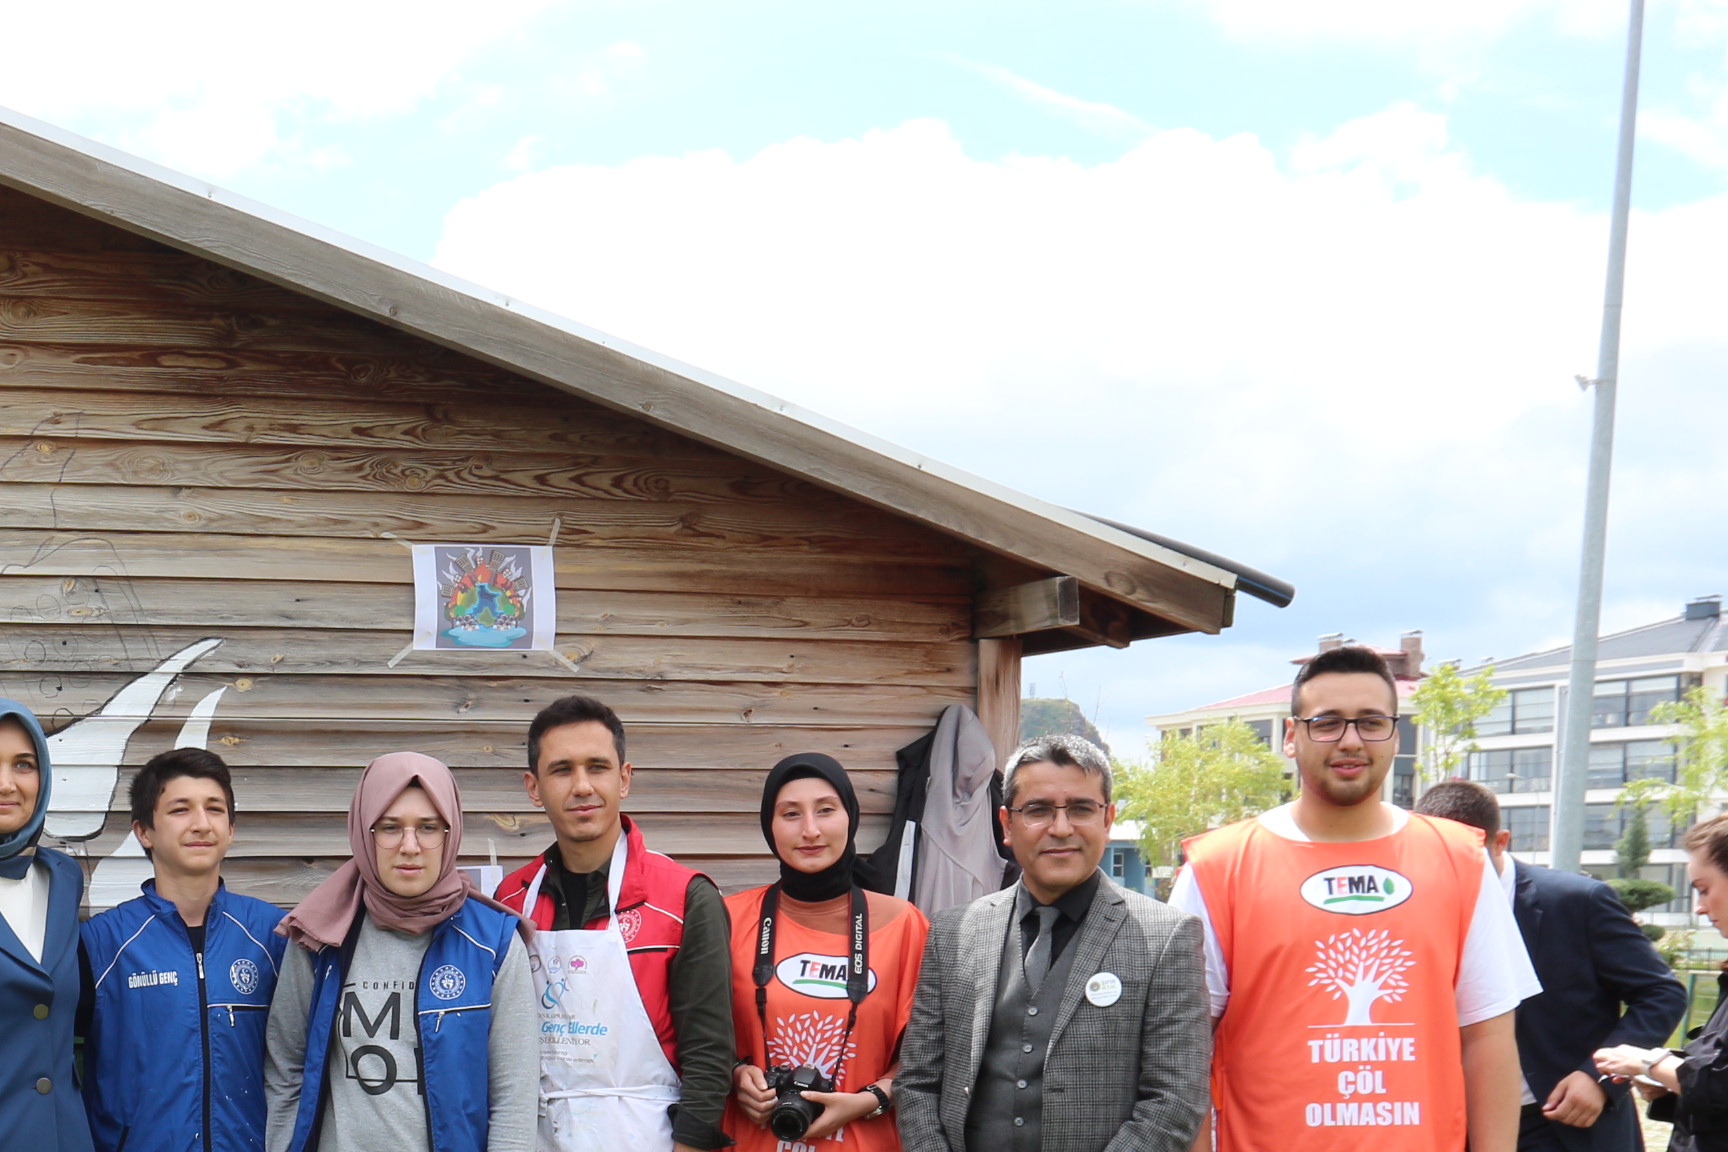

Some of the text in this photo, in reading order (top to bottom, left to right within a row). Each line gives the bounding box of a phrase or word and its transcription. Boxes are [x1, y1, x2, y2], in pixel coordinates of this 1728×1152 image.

[1324, 875, 1379, 895] TEMA
[760, 917, 772, 955] Canon
[854, 913, 863, 974] EOS DIGITAL
[128, 970, 179, 989] GÖNÜLLÜ GENÇ
[800, 959, 849, 980] TEMA
[541, 1021, 608, 1036] Genç Ellerde
[1307, 1031, 1416, 1063] TÜRKİYE
[1337, 1065, 1387, 1099] ÇÖL
[1305, 1102, 1420, 1127] OLMASIN
